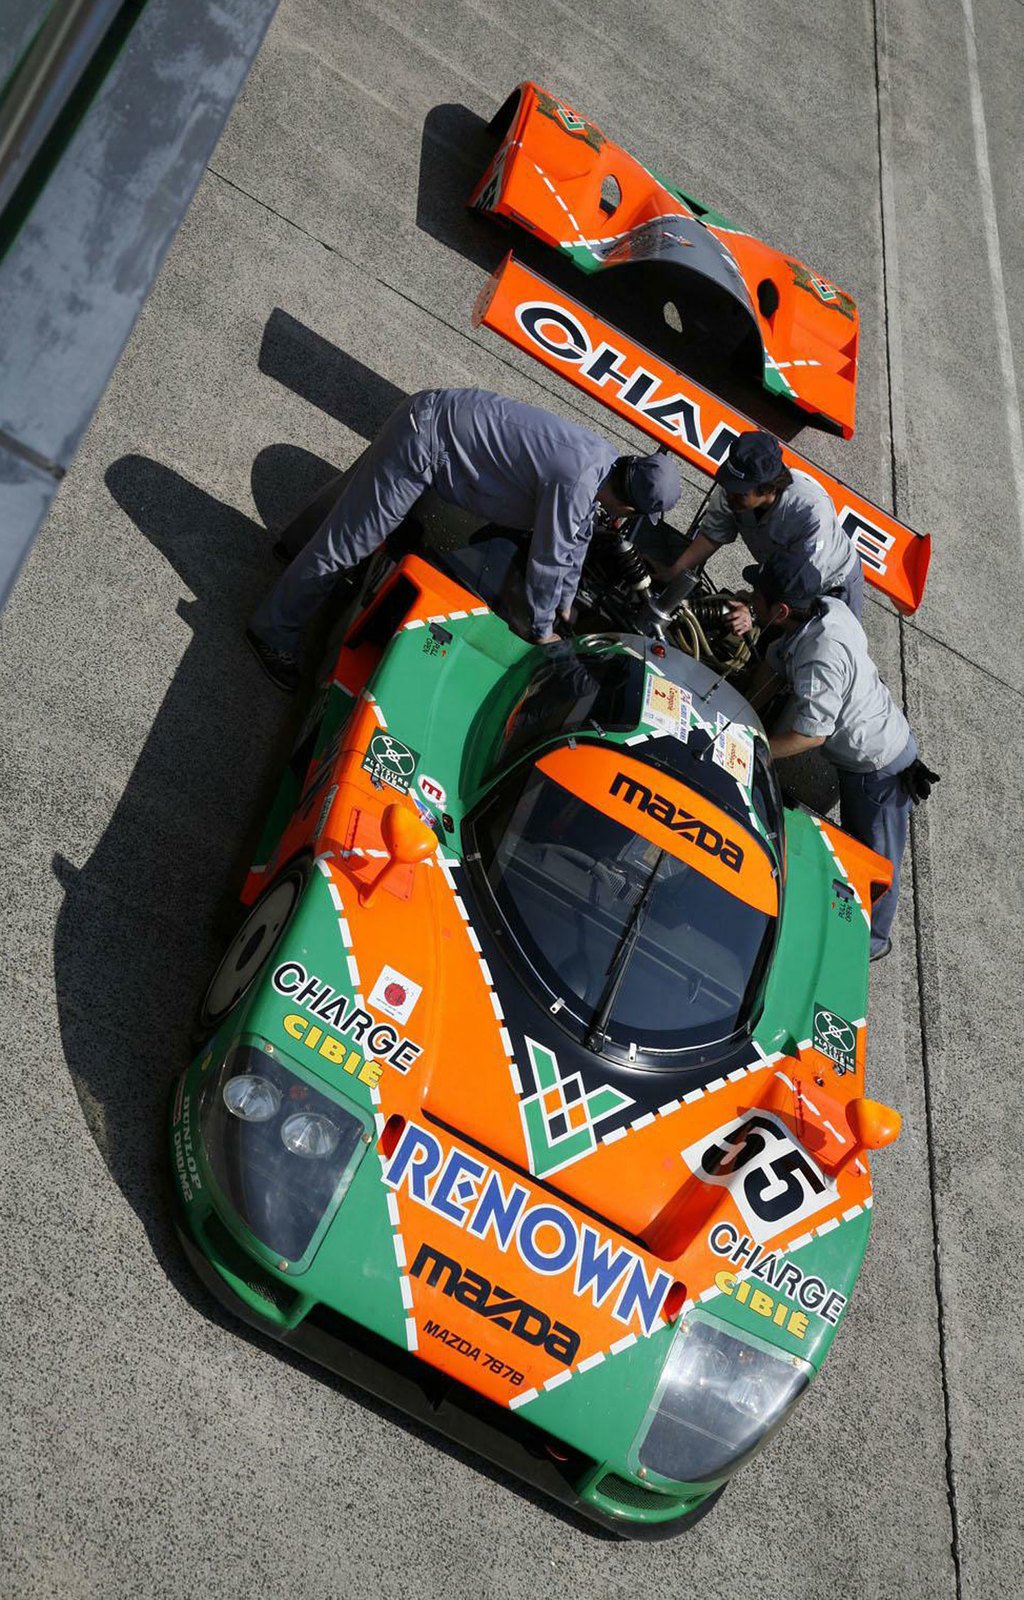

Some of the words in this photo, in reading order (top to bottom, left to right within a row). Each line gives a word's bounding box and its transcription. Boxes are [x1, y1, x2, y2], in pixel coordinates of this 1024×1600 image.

[515, 301, 896, 576] CHAE
[654, 689, 667, 699] 2
[736, 757, 747, 769] 2
[271, 961, 424, 1076] CHARGE
[282, 1013, 384, 1089] CIBIÉ
[183, 1096, 202, 1190] DUNLOP
[701, 1115, 827, 1223] 55
[380, 1120, 675, 1338] RENOWN
[708, 1221, 848, 1327] CHARGE
[714, 1269, 810, 1341] CIBIÉ
[423, 1319, 481, 1362] MAZDA
[481, 1352, 525, 1387] 787B
